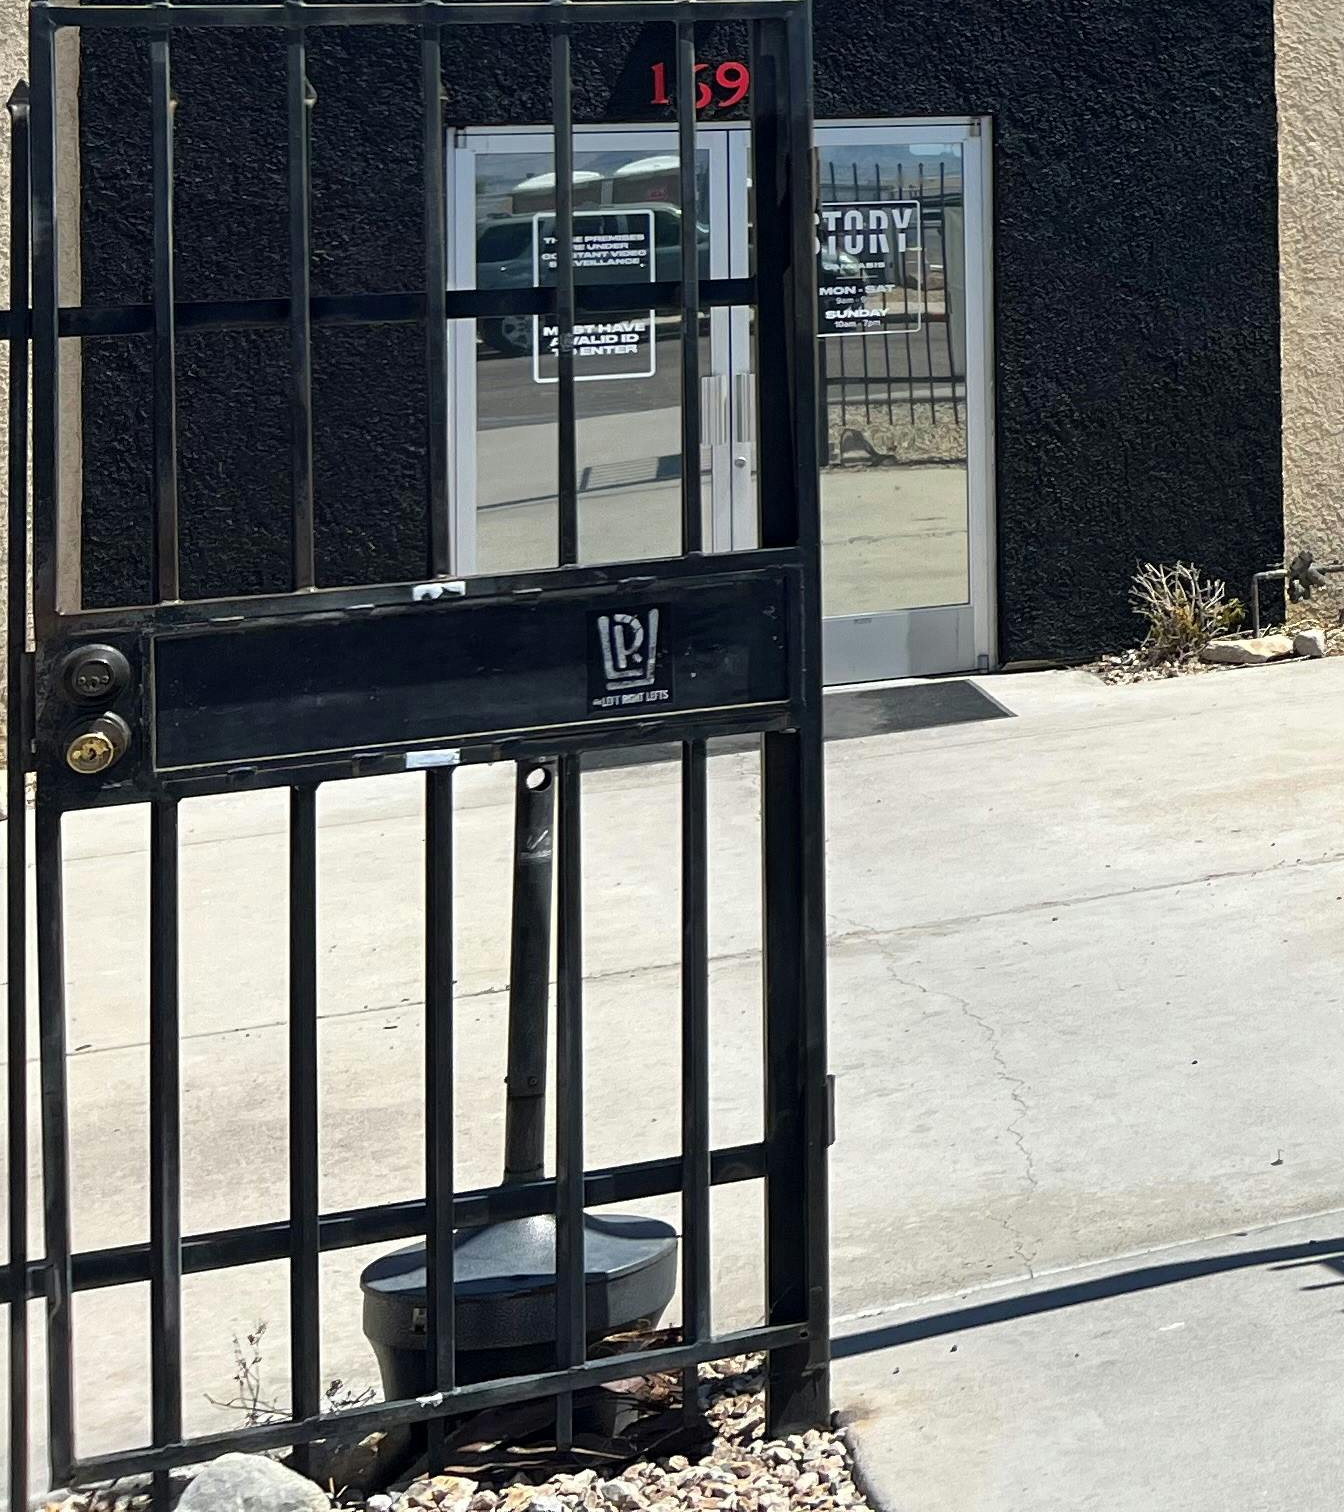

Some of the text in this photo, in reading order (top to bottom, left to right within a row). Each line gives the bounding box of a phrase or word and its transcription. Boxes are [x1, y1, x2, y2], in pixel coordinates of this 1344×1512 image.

[584, 233, 645, 243] PREMISES
[586, 242, 630, 251] UNDER
[610, 249, 647, 258] VIDEO
[549, 258, 640, 268] SVEILLANCE
[819, 286, 857, 296] MON
[864, 284, 896, 294] SAT
[825, 308, 889, 319] SUNDAY
[543, 321, 647, 336] MST HAVE
[620, 333, 640, 343] ID
[579, 344, 638, 356] ENTER
